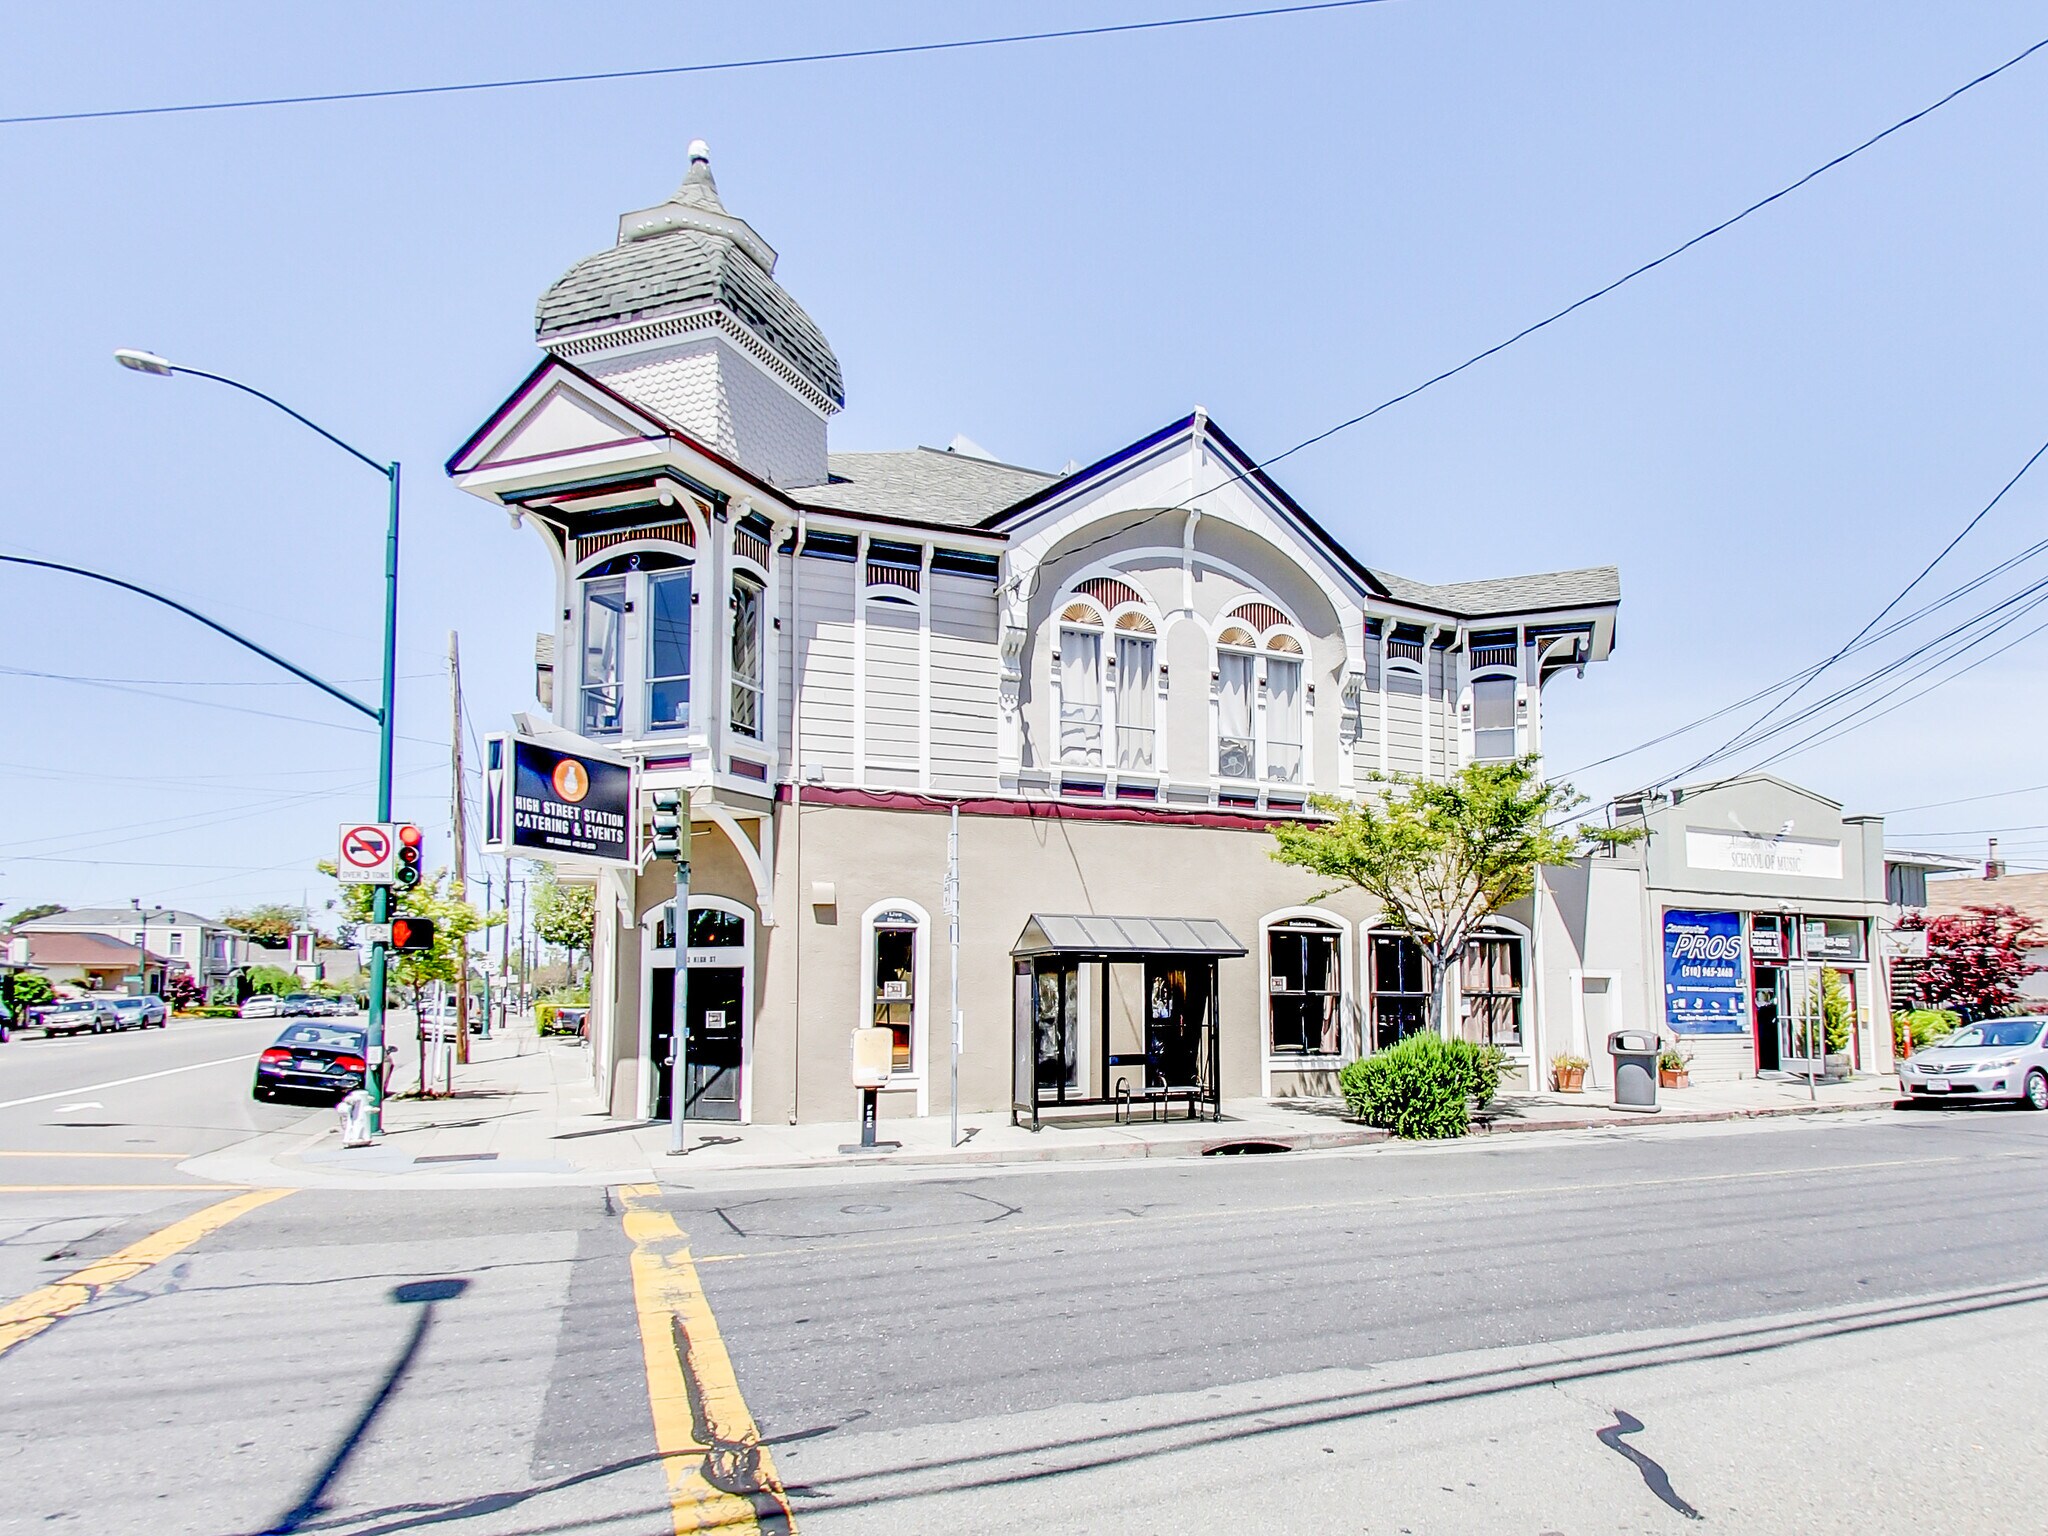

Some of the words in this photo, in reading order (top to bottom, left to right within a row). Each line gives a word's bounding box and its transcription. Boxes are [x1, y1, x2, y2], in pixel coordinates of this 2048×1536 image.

[515, 796, 540, 812] HIGH
[543, 801, 581, 820] STREET
[583, 808, 624, 828] STATION
[515, 812, 569, 834] CATERING
[573, 822, 582, 836] &
[585, 824, 624, 843] EVENTS
[1731, 851, 1764, 869] SCHOOL
[1764, 854, 1775, 870] OF
[1777, 855, 1801, 872] MUSIC
[364, 870, 370, 880] 3
[1665, 923, 1709, 935] Computer
[1672, 934, 1742, 960] PROS
[481, 961, 495, 969] 25
[1682, 964, 1701, 978] (510)
